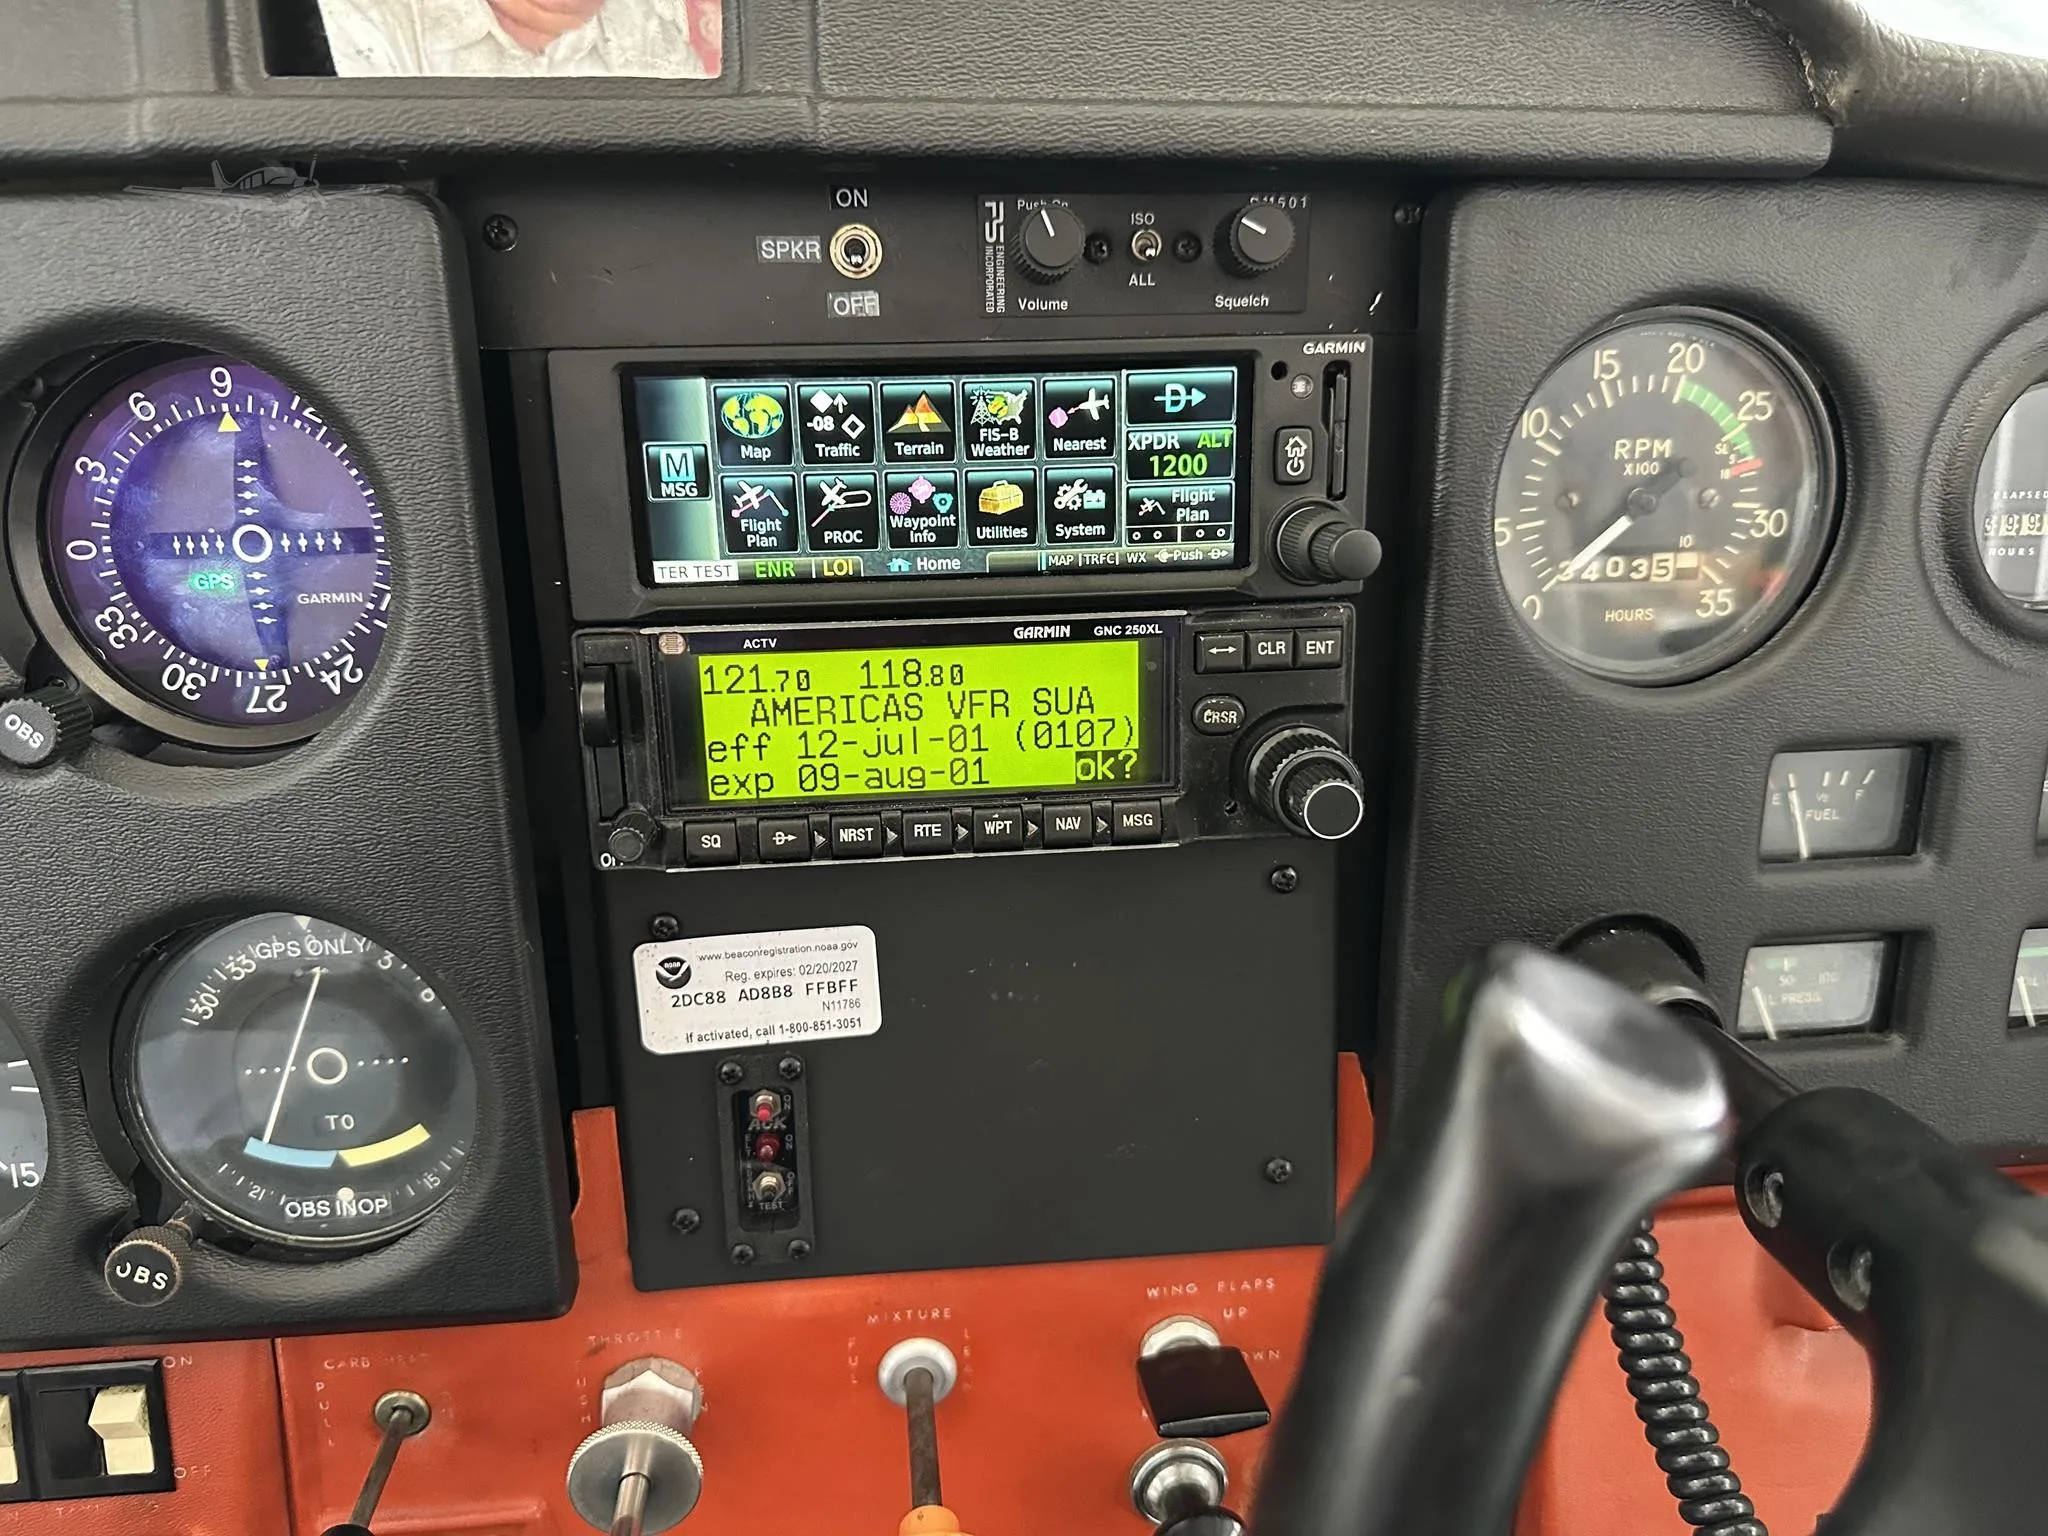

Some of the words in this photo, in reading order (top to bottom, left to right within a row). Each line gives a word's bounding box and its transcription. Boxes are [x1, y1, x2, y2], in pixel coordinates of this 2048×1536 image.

[836, 188, 868, 207] ON
[1131, 213, 1155, 226] ISO
[761, 240, 821, 260] SPKR
[985, 245, 995, 313] INCORPORATED
[995, 245, 1005, 313] ENGINEERING
[1128, 273, 1156, 287] ALL
[834, 296, 878, 315] OFF
[1017, 296, 1069, 311] Volume
[1214, 294, 1270, 311] Squelch
[1302, 340, 1367, 355] GARMIN
[1592, 349, 1622, 380] 15
[1666, 342, 1705, 374] 20
[209, 367, 233, 398] 9
[127, 390, 158, 423] 6
[1737, 390, 1775, 422] 25
[806, 415, 835, 432] -08
[1520, 407, 1550, 439] 10
[979, 427, 1020, 442] FIS-B
[1127, 432, 1181, 451] XPDR
[1196, 429, 1232, 450] ALT
[740, 444, 772, 461] Map
[815, 443, 860, 458] Traffic
[894, 441, 945, 457] Terrain
[970, 442, 1030, 457] Weather
[1052, 436, 1107, 452] Nearest
[1613, 438, 1673, 460] RPM
[74, 455, 108, 483] 3
[664, 451, 691, 477] M
[1149, 453, 1209, 478] 1200
[1623, 461, 1660, 476] X100
[661, 481, 699, 499] MSG
[1171, 487, 1216, 507] Flight
[889, 513, 957, 531] Waypoint
[1176, 507, 1210, 523] Plan
[1749, 508, 1790, 538] 30
[741, 519, 783, 536] Flight
[909, 529, 937, 544] Info
[976, 524, 1029, 540] Utilities
[1054, 522, 1106, 539] System
[1494, 518, 1512, 547] 5
[746, 533, 778, 549] Plan
[823, 530, 864, 545] PROC
[1678, 534, 1693, 549] 10
[65, 539, 98, 562] 0
[1048, 552, 1075, 567] MAP
[1083, 551, 1116, 567] TRFC
[1126, 550, 1148, 564] WX
[1172, 547, 1204, 562] Push
[658, 565, 692, 580] TER
[694, 564, 733, 579] TEST
[754, 560, 796, 578] ENR
[822, 559, 854, 577] LOI
[916, 556, 962, 572] Home
[193, 571, 236, 592] GPS
[296, 592, 364, 605] GARMIN
[1695, 588, 1737, 619] 35
[1604, 608, 1654, 623] HOURS
[93, 604, 140, 651] 33
[1013, 624, 1071, 639] GARMIN
[1093, 625, 1123, 637] GNC
[1124, 622, 1163, 636] 250XL
[742, 637, 778, 649] ACTV
[1257, 640, 1286, 656] CLR
[1305, 640, 1335, 655] ENT
[160, 661, 208, 702] 30
[318, 652, 365, 696] 24
[702, 662, 812, 696] 121.70
[859, 657, 965, 691] 118.80
[245, 683, 289, 714] 27
[750, 692, 924, 728] AMERICAS
[947, 688, 1010, 720] VFR
[1032, 685, 1096, 717] SUA
[1202, 709, 1238, 724] CRSR
[4, 713, 46, 750] OBS
[707, 731, 772, 764] eff
[797, 722, 990, 761] 12-jul-01
[1015, 715, 1134, 752] (0107)
[710, 771, 775, 800] exp
[797, 756, 991, 793] 09-aug-01
[1075, 748, 1139, 782] ok?
[1122, 812, 1154, 829] MSG
[1804, 807, 1841, 821] FUEL
[913, 822, 943, 838] RTE
[984, 819, 1014, 836] WPT
[1054, 815, 1082, 832] NAV
[700, 833, 722, 849] SQ
[839, 826, 875, 843] NRST
[255, 940, 301, 959] GPS
[307, 935, 369, 957] ONLY
[697, 939, 859, 962] www.beaconregistration.noaa.gov
[224, 954, 258, 982] 33
[724, 970, 751, 984] Reg.
[753, 966, 797, 982] expires:
[798, 960, 859, 977] 02/20/2027
[670, 990, 727, 1009] 2DC88
[737, 984, 794, 1003] AD8B8
[804, 978, 859, 997] FFBFF
[191, 992, 222, 1021] 30
[821, 997, 862, 1013] N11786
[685, 1031, 696, 1044] If
[696, 1026, 753, 1043] activated,
[755, 1024, 776, 1037] call
[778, 1016, 863, 1035] 1-800-851-3051
[9, 1161, 41, 1189] 15
[284, 1199, 331, 1218] OBS
[336, 1196, 390, 1217] INOP
[759, 1201, 784, 1211] TEST
[1146, 1282, 1199, 1299] WING
[867, 1306, 952, 1325] MIXTURE
[1222, 1306, 1248, 1320] UP
[162, 1355, 194, 1369] ON
